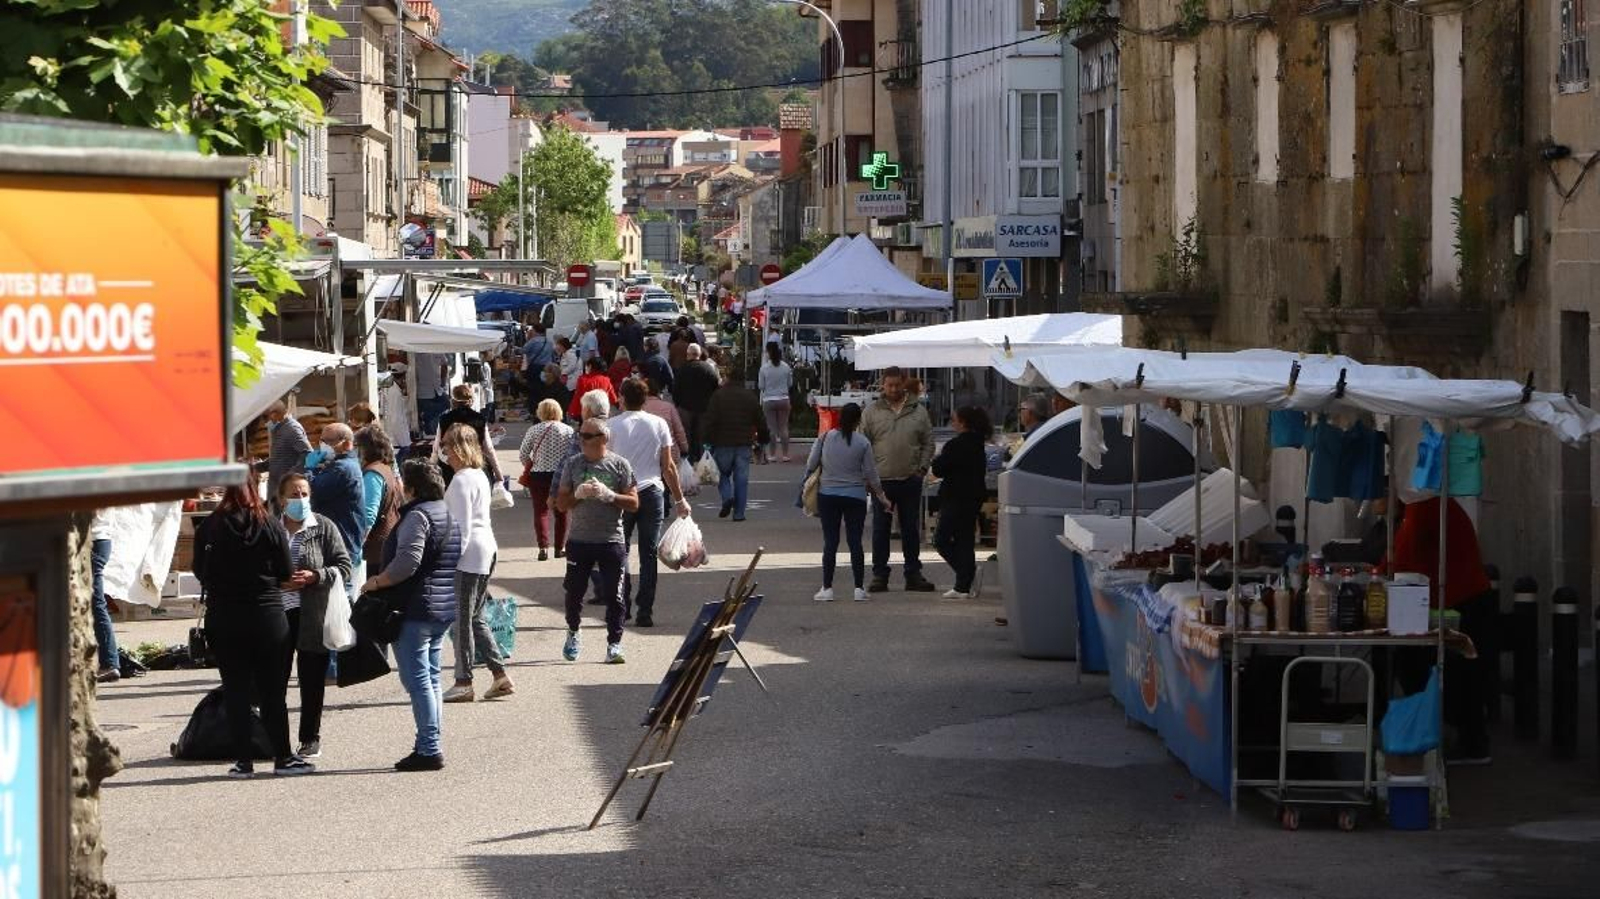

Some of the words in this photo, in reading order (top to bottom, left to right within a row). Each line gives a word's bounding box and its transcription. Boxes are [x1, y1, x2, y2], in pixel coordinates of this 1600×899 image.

[859, 193, 902, 202] FARMACIA
[999, 225, 1058, 236] SARCASA
[38, 273, 64, 296] DE
[65, 273, 97, 296] ATA
[0, 303, 155, 352] 00.000€
